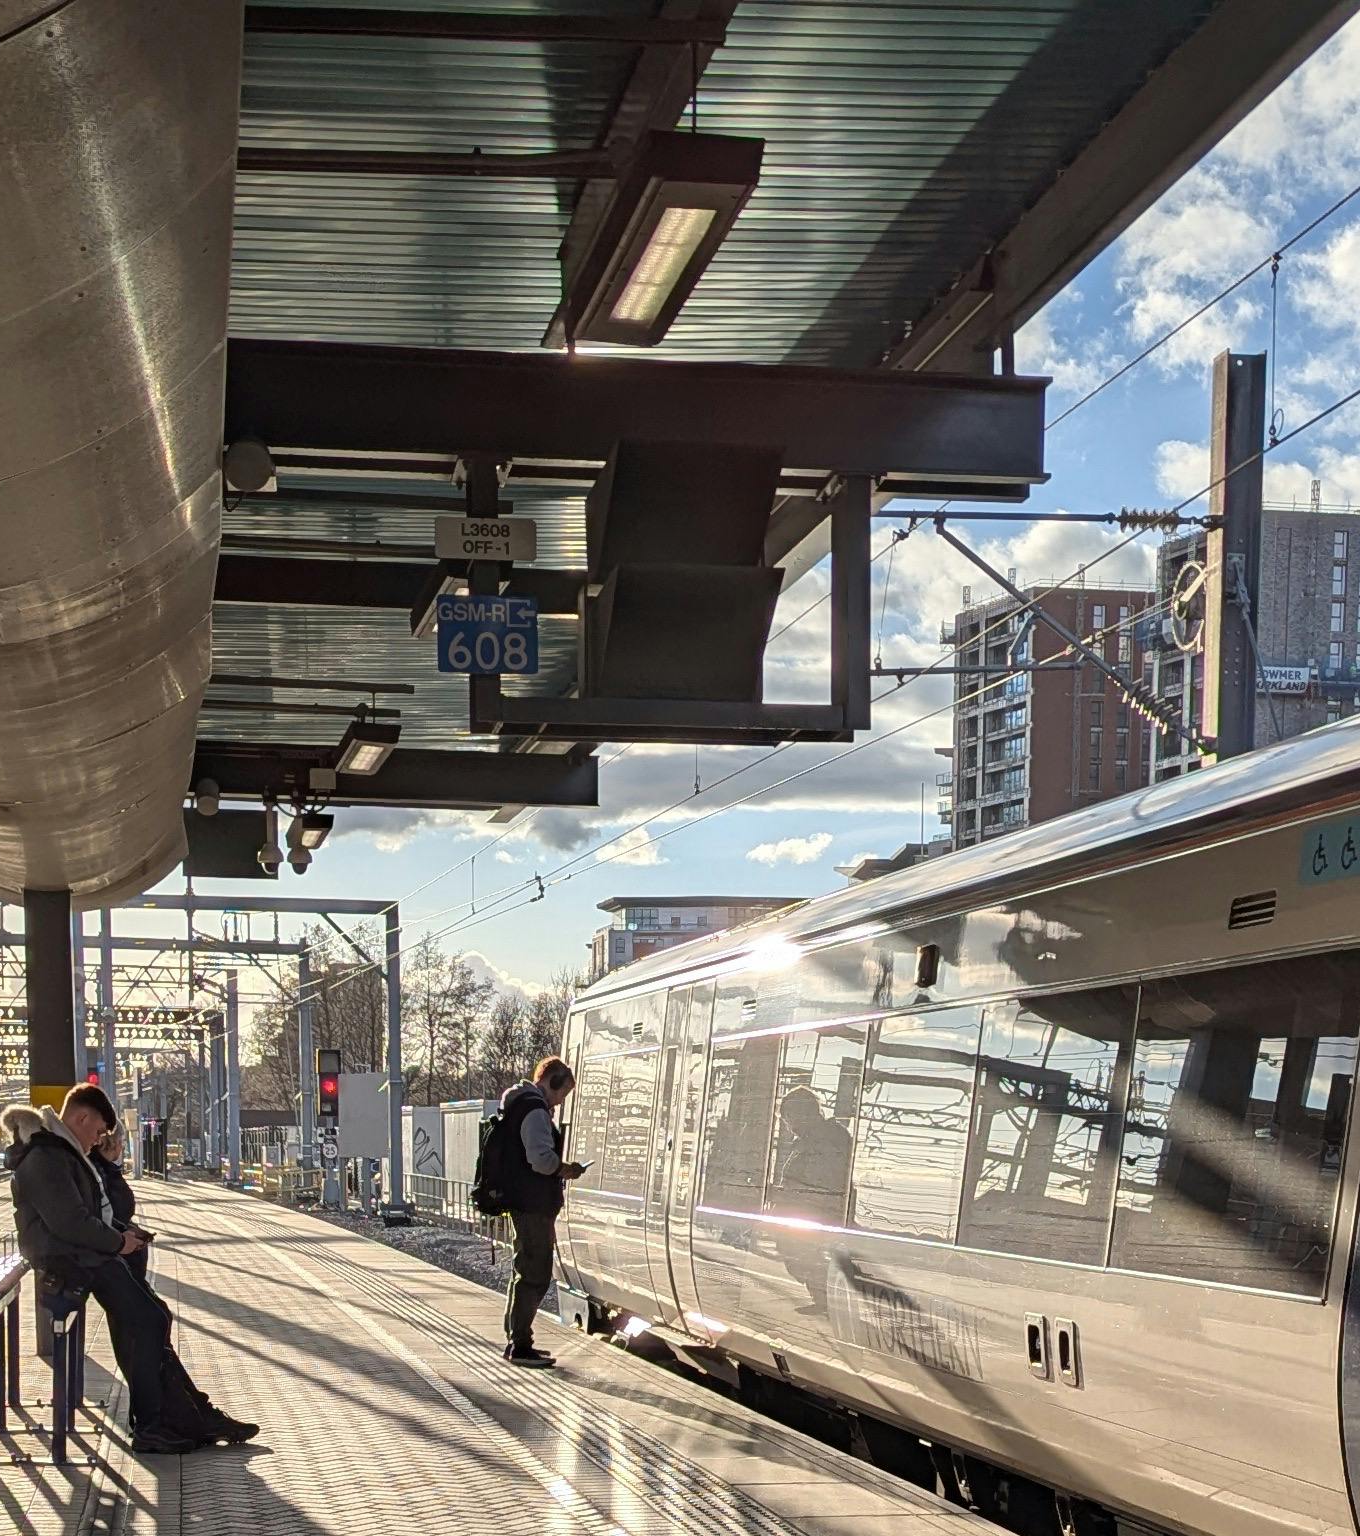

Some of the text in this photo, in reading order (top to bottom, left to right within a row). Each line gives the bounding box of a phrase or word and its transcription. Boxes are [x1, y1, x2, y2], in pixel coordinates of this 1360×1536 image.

[461, 522, 511, 538] L3608
[438, 602, 506, 623] GSM-R
[448, 631, 529, 671] 608
